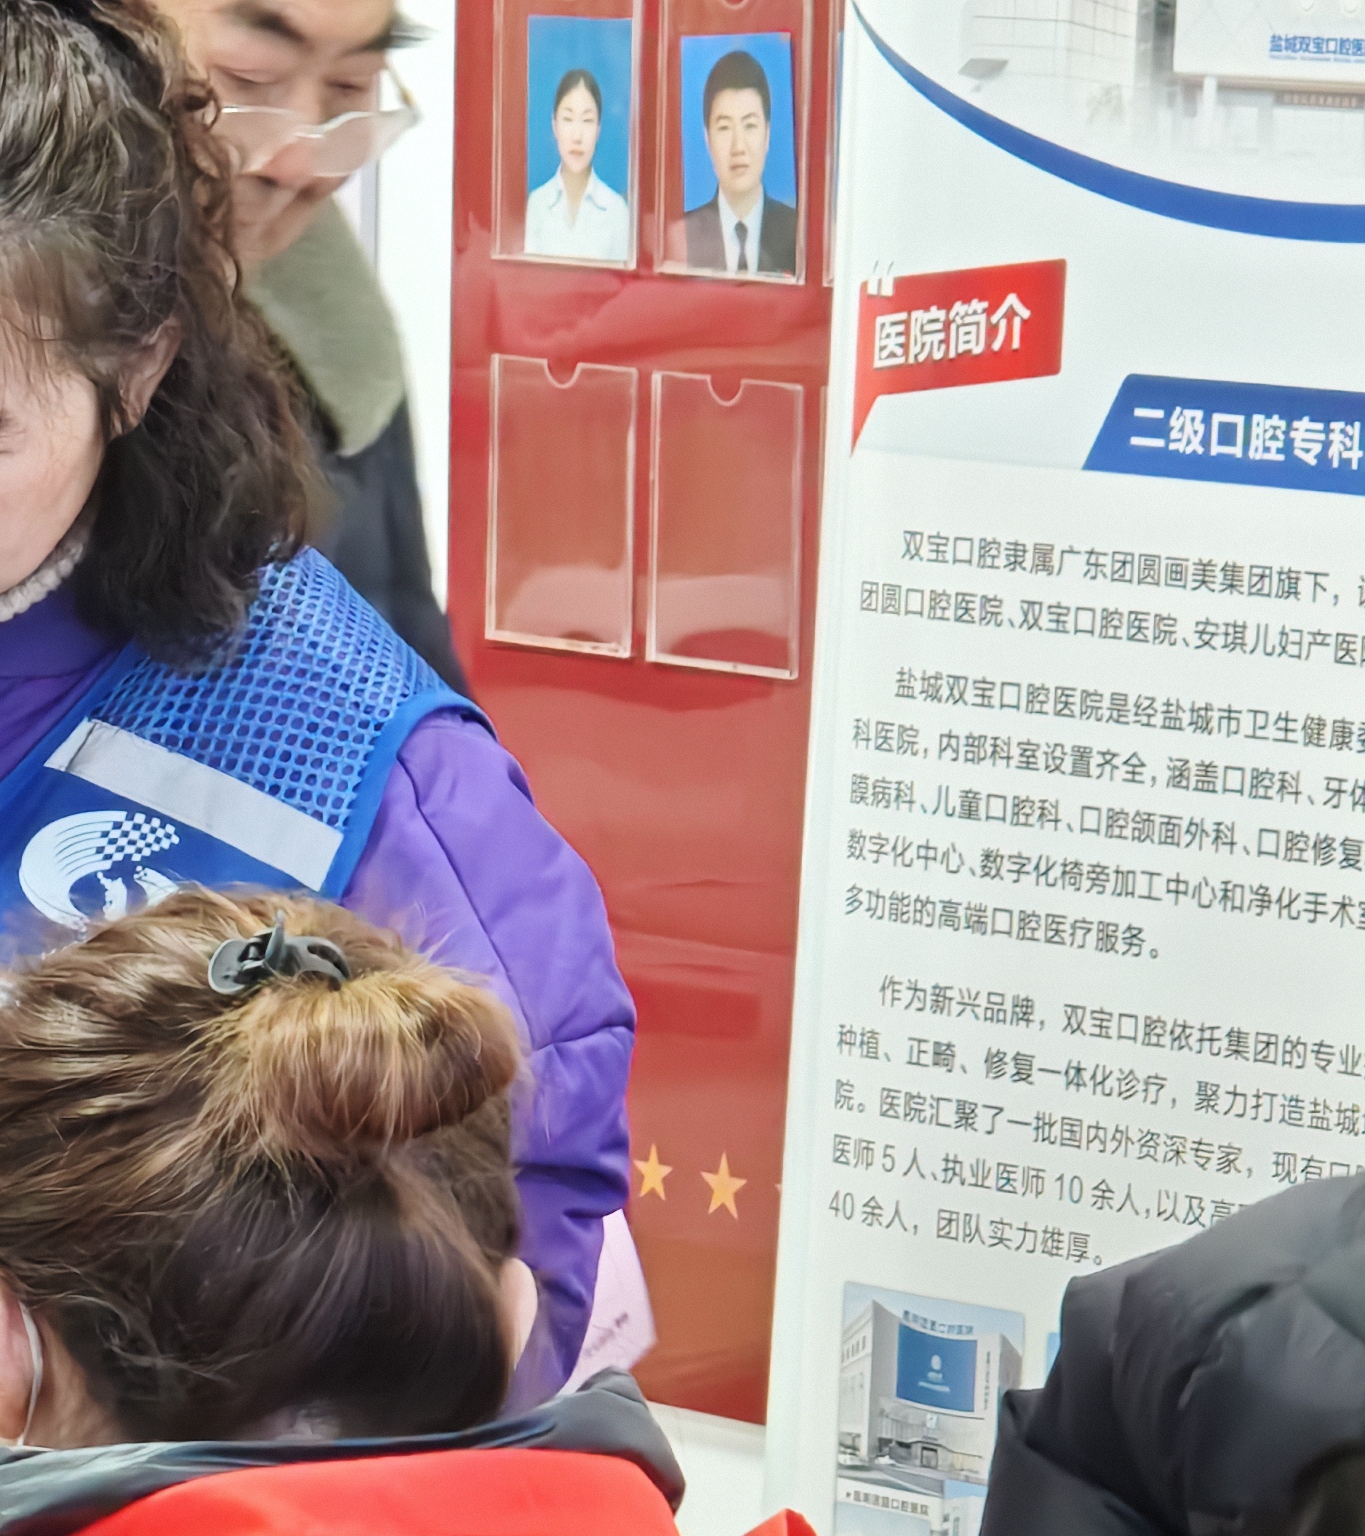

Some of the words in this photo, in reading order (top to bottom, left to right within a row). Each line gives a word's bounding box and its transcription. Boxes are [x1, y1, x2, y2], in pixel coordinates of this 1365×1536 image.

[873, 292, 1031, 369] 医院简介
[1130, 406, 1363, 471] 二级口腔专科
[859, 580, 1365, 668] 团圆口腔医院、双宝口腔医院、安琪儿妇产医
[844, 884, 1160, 959] 多功能的高端口腔医疗服务。
[836, 1023, 1365, 1137] 种植、正畸、修复一体化诊疗，聚力打造盐城
[834, 1079, 1365, 1184] 院。医院汇聚了一批国内外资深专家，现有
